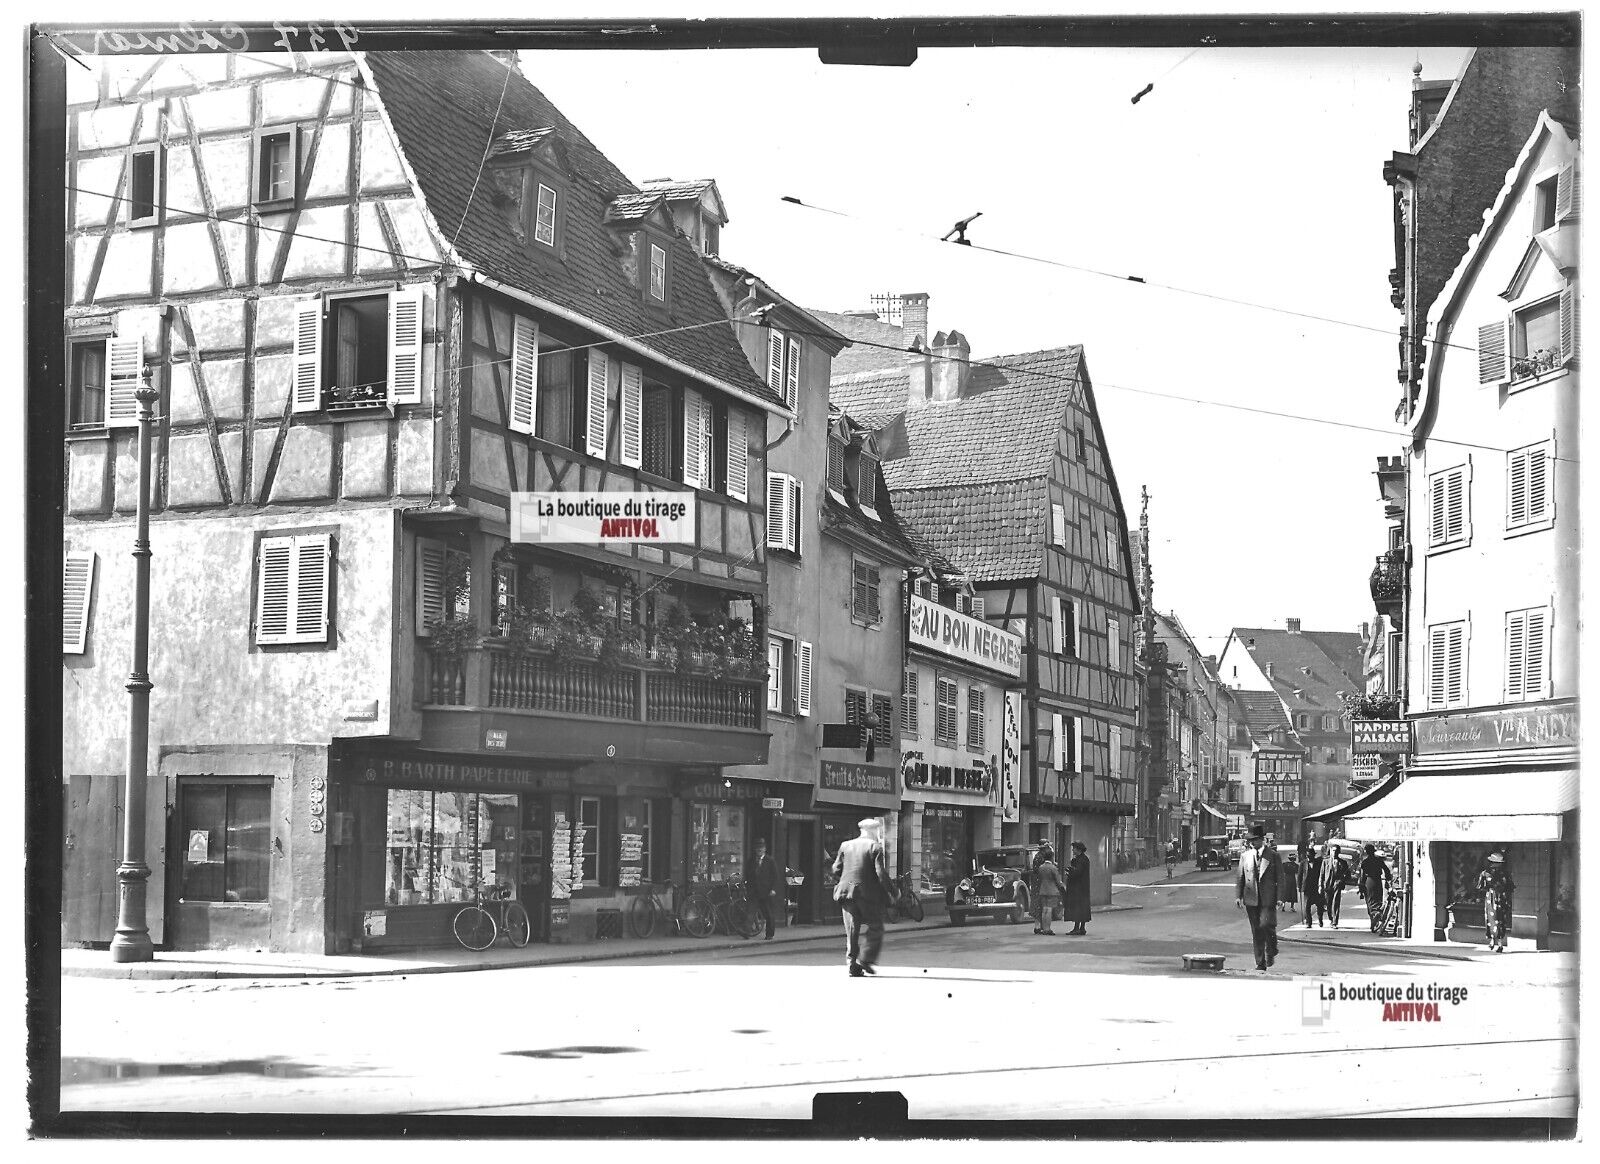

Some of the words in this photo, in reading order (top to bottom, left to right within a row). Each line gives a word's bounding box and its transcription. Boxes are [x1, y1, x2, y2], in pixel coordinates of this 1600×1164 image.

[921, 605, 940, 641] AU
[943, 614, 970, 653] BON
[1354, 722, 1409, 732] NAPPES
[401, 762, 455, 781] BARTH
[460, 765, 533, 785] PAPETERIE
